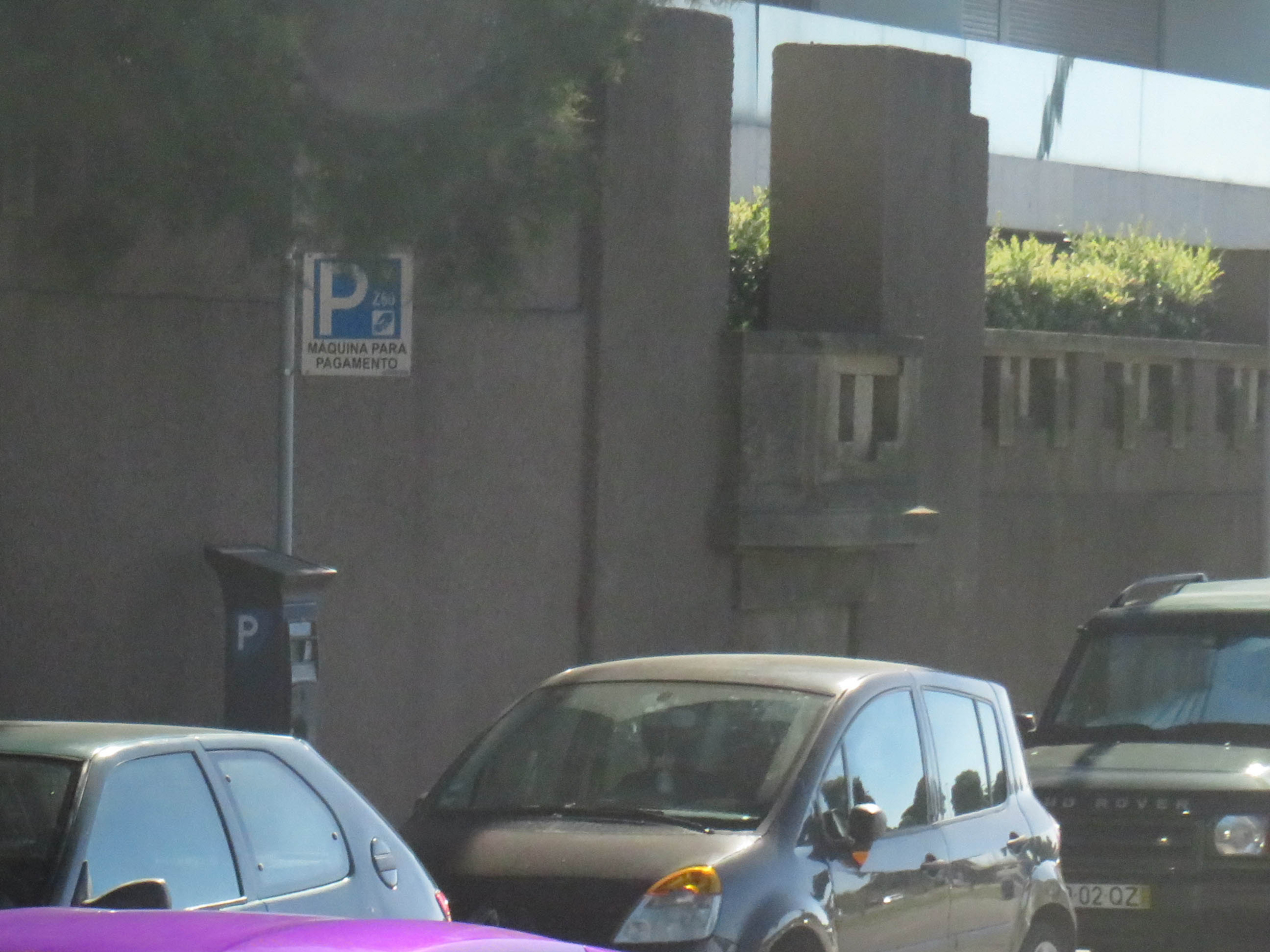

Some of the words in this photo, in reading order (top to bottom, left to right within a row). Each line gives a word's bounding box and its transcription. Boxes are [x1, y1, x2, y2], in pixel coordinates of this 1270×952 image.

[319, 262, 368, 336] P
[371, 342, 407, 355] PARA
[316, 357, 397, 370] PAGAMENTO
[237, 614, 259, 651] P
[1095, 797, 1190, 809] ROVER
